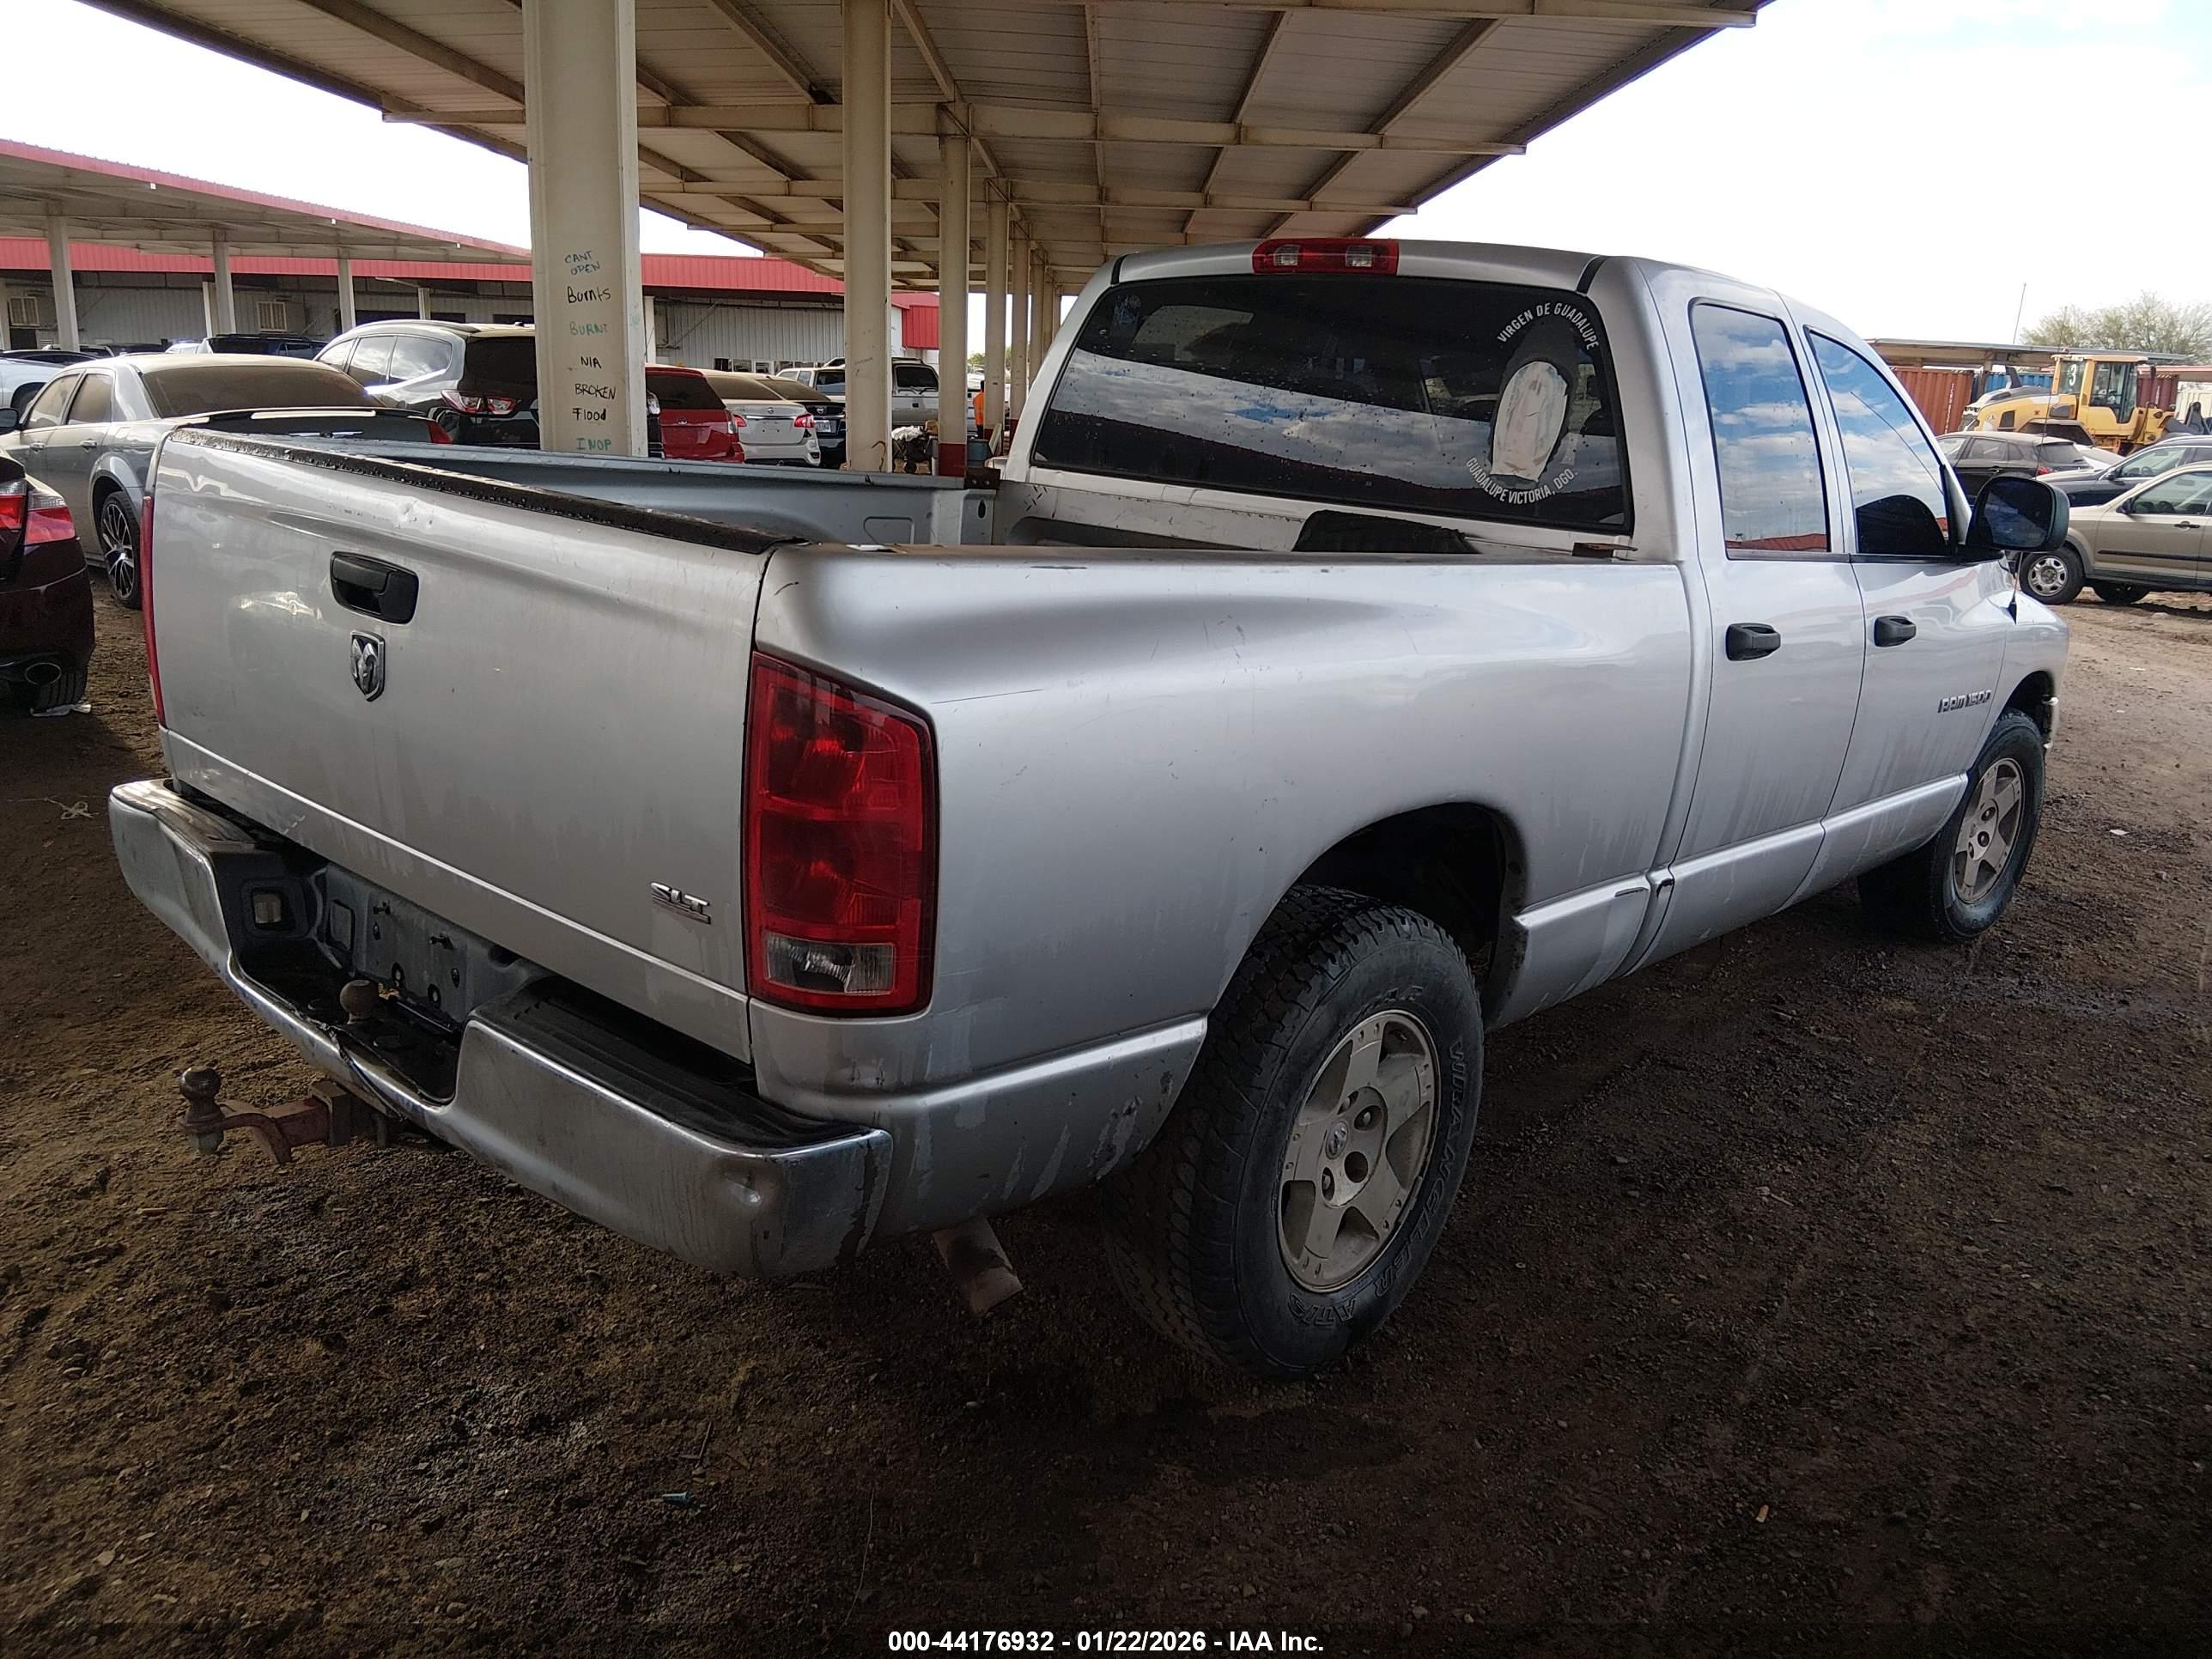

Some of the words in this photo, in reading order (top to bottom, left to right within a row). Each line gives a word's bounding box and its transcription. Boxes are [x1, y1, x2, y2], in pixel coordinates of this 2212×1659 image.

[564, 251, 593, 264] CANT
[570, 262, 600, 275] OPEN
[569, 321, 609, 336] BURNT
[1498, 309, 1534, 343] VIRGEN
[1536, 302, 1551, 316] DE
[1553, 302, 1600, 350] GUADALUPE
[574, 383, 617, 400] BROKEN
[576, 438, 611, 452] INOP
[1466, 457, 1508, 502] GUADALUPE
[1508, 484, 1556, 505] VICTORIA,
[1555, 468, 1579, 489] DGO.
[1937, 695, 1966, 714] RAM
[1966, 690, 1992, 708] 1500
[650, 881, 710, 925] SLT
[1373, 1040, 1467, 1299] WRANGLER
